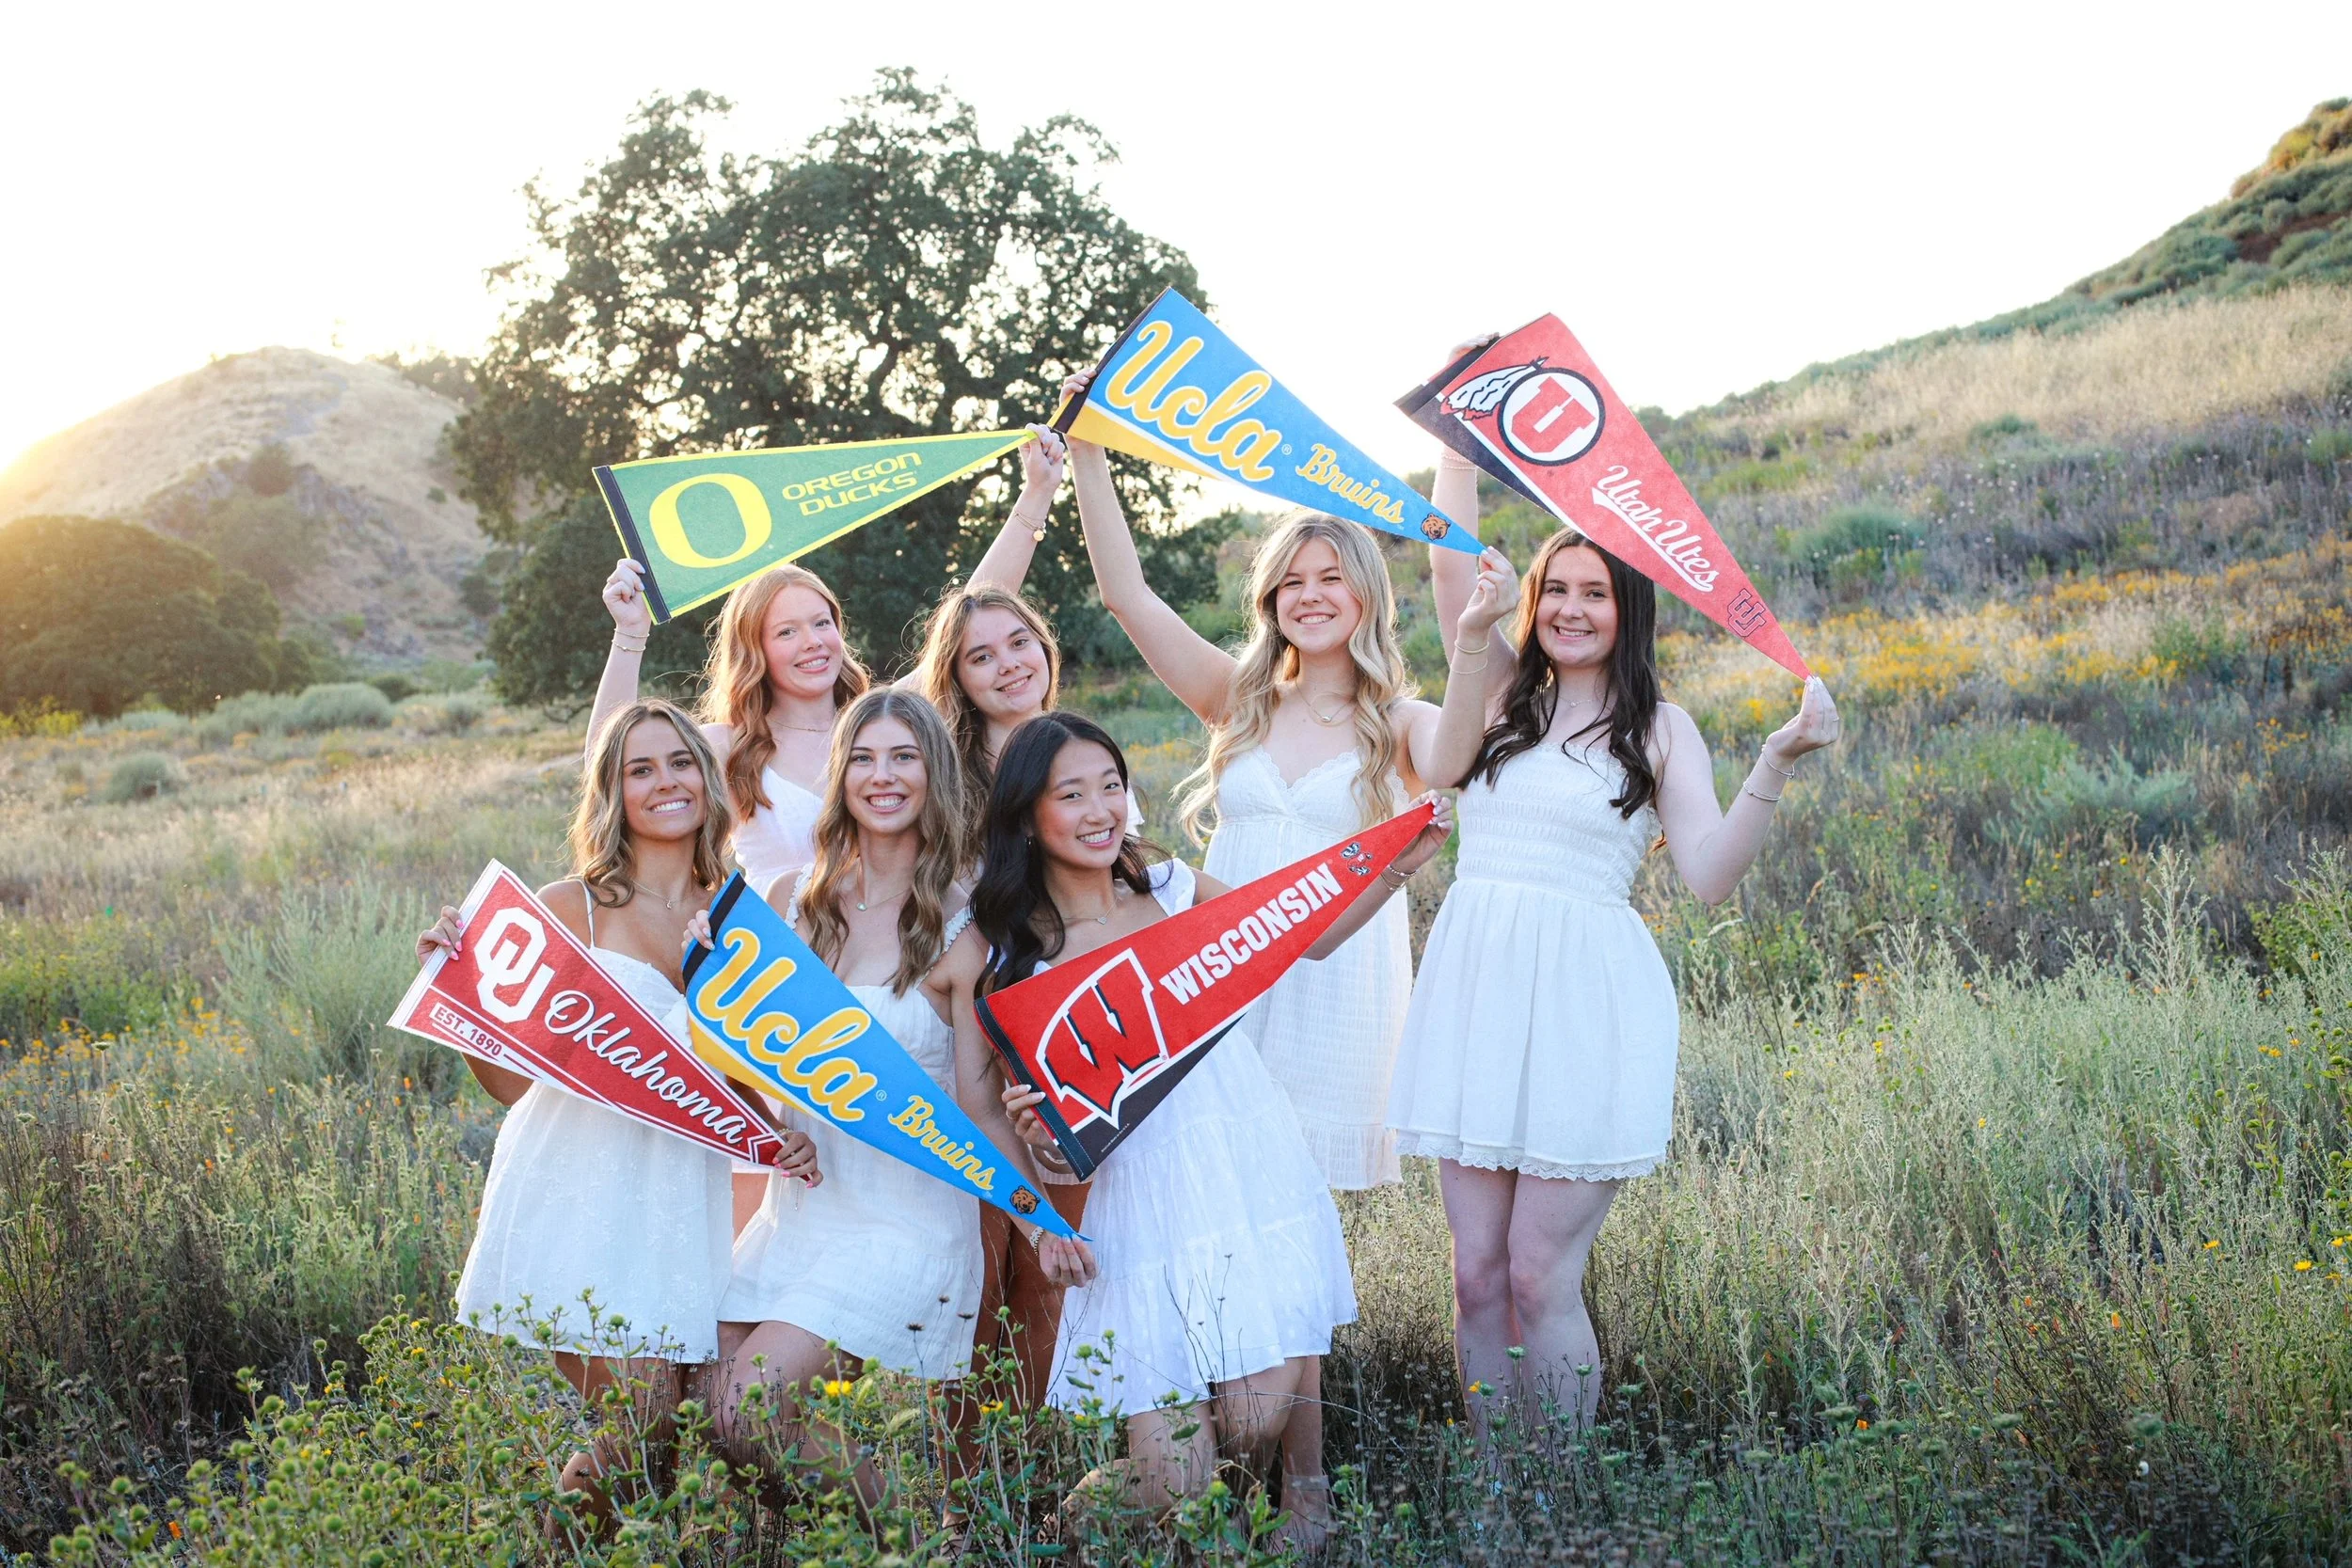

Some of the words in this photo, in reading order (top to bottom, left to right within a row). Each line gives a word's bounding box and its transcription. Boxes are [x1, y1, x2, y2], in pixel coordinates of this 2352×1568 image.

[782, 451, 922, 500] OREGON
[1105, 320, 1282, 483] Ucla
[1295, 443, 1405, 524] Bruins
[1511, 376, 1596, 453] U
[799, 471, 918, 516] DUCKS
[1597, 465, 1662, 532] Utah
[1655, 519, 1720, 588] Utes
[1159, 862, 1343, 1006] WISCONSIN
[434, 1006, 465, 1035] EST.
[469, 1028, 502, 1055] 1890
[544, 990, 748, 1145] Oklahoma
[695, 927, 878, 1122] Ucla
[887, 1095, 995, 1192] Bruins
[1035, 947, 1169, 1130] W
